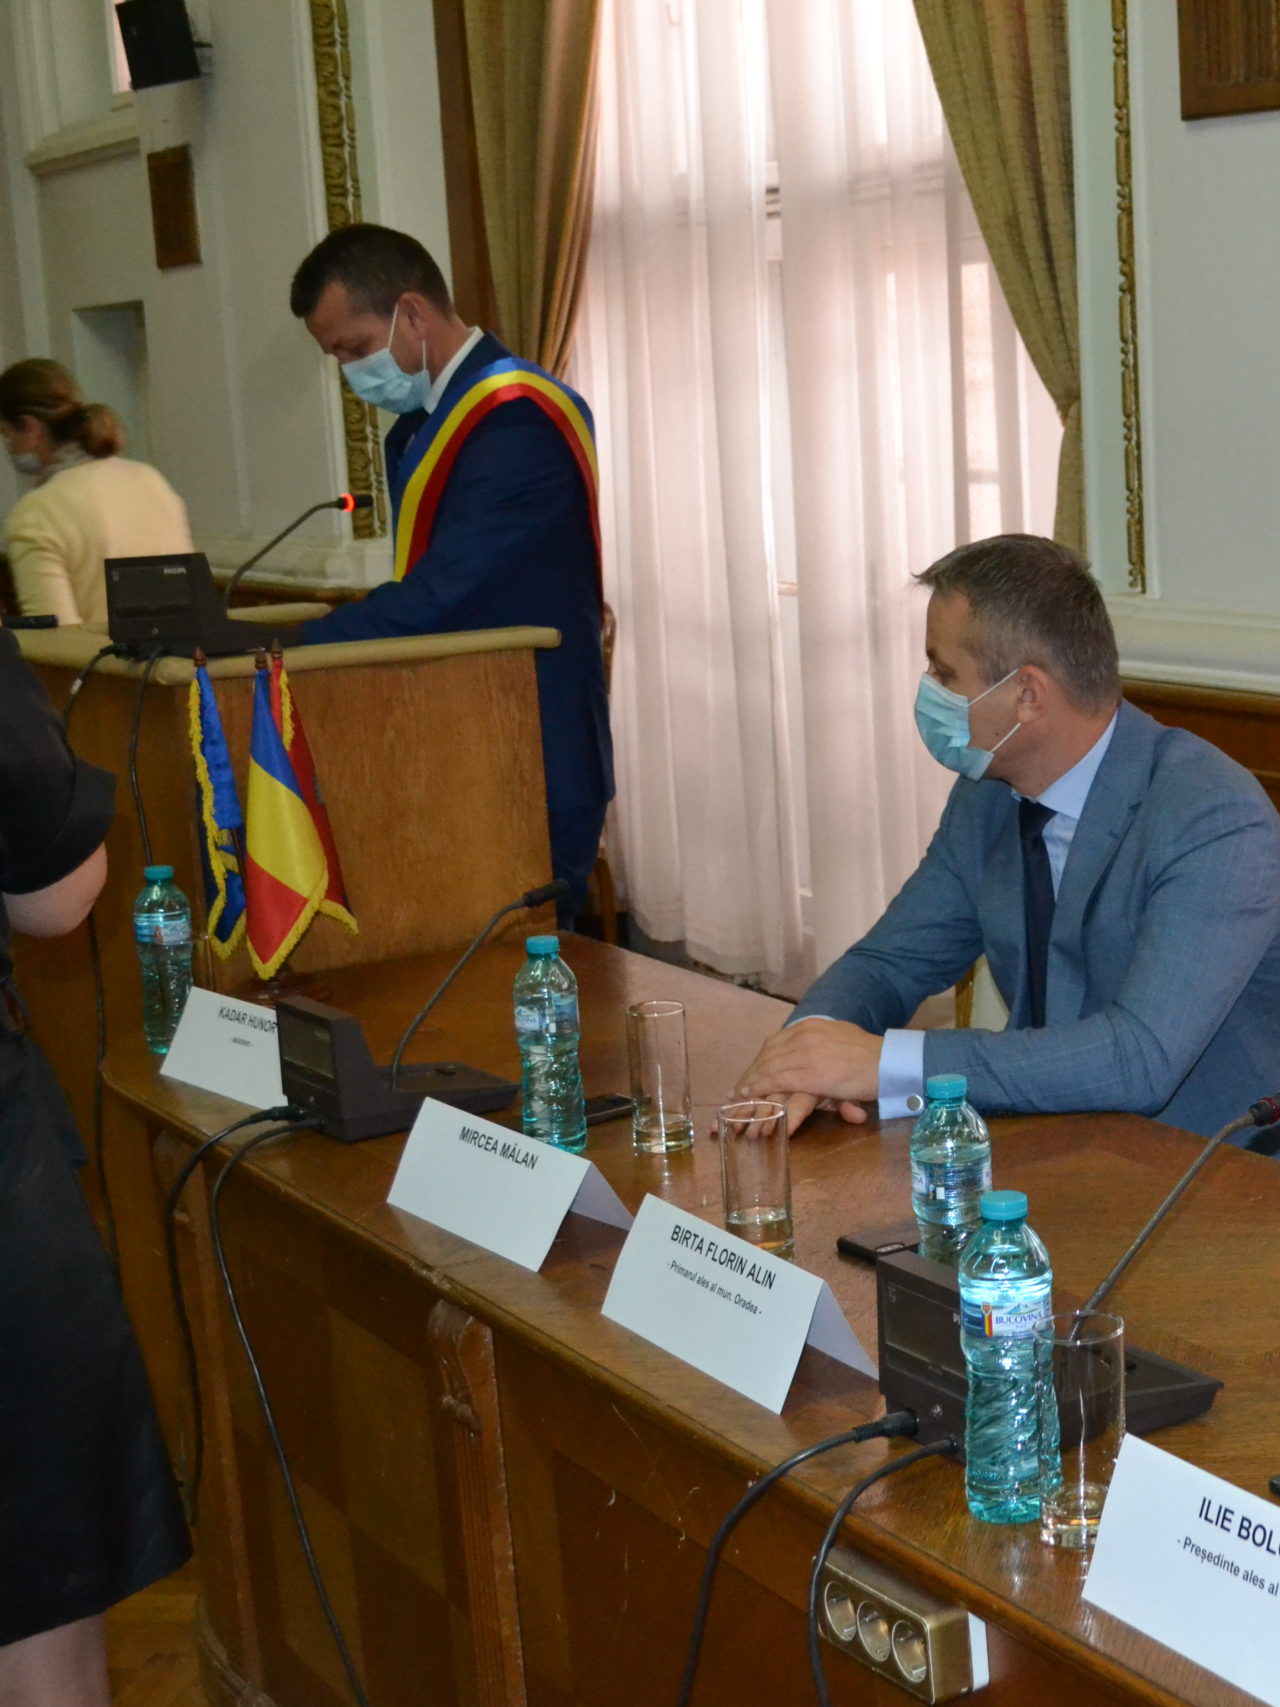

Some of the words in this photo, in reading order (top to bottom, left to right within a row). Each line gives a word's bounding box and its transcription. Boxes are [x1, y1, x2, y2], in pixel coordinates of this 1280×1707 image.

[218, 1006, 246, 1026] KADAR
[248, 1015, 277, 1034] HUNOR
[459, 1126, 499, 1154] MIRCEA
[670, 1224, 705, 1255] BIRTA
[705, 1242, 748, 1275] FLORIN
[746, 1263, 777, 1290] ALIN
[670, 1260, 698, 1283] Primarul
[696, 1274, 710, 1289] ales
[710, 1281, 718, 1293] al
[734, 1293, 758, 1315] Oradea
[995, 1313, 1043, 1325] BUCOVINA
[1198, 1496, 1235, 1533] ILIE
[1242, 1569, 1266, 1590] ales
[1268, 1581, 1280, 1597] al
